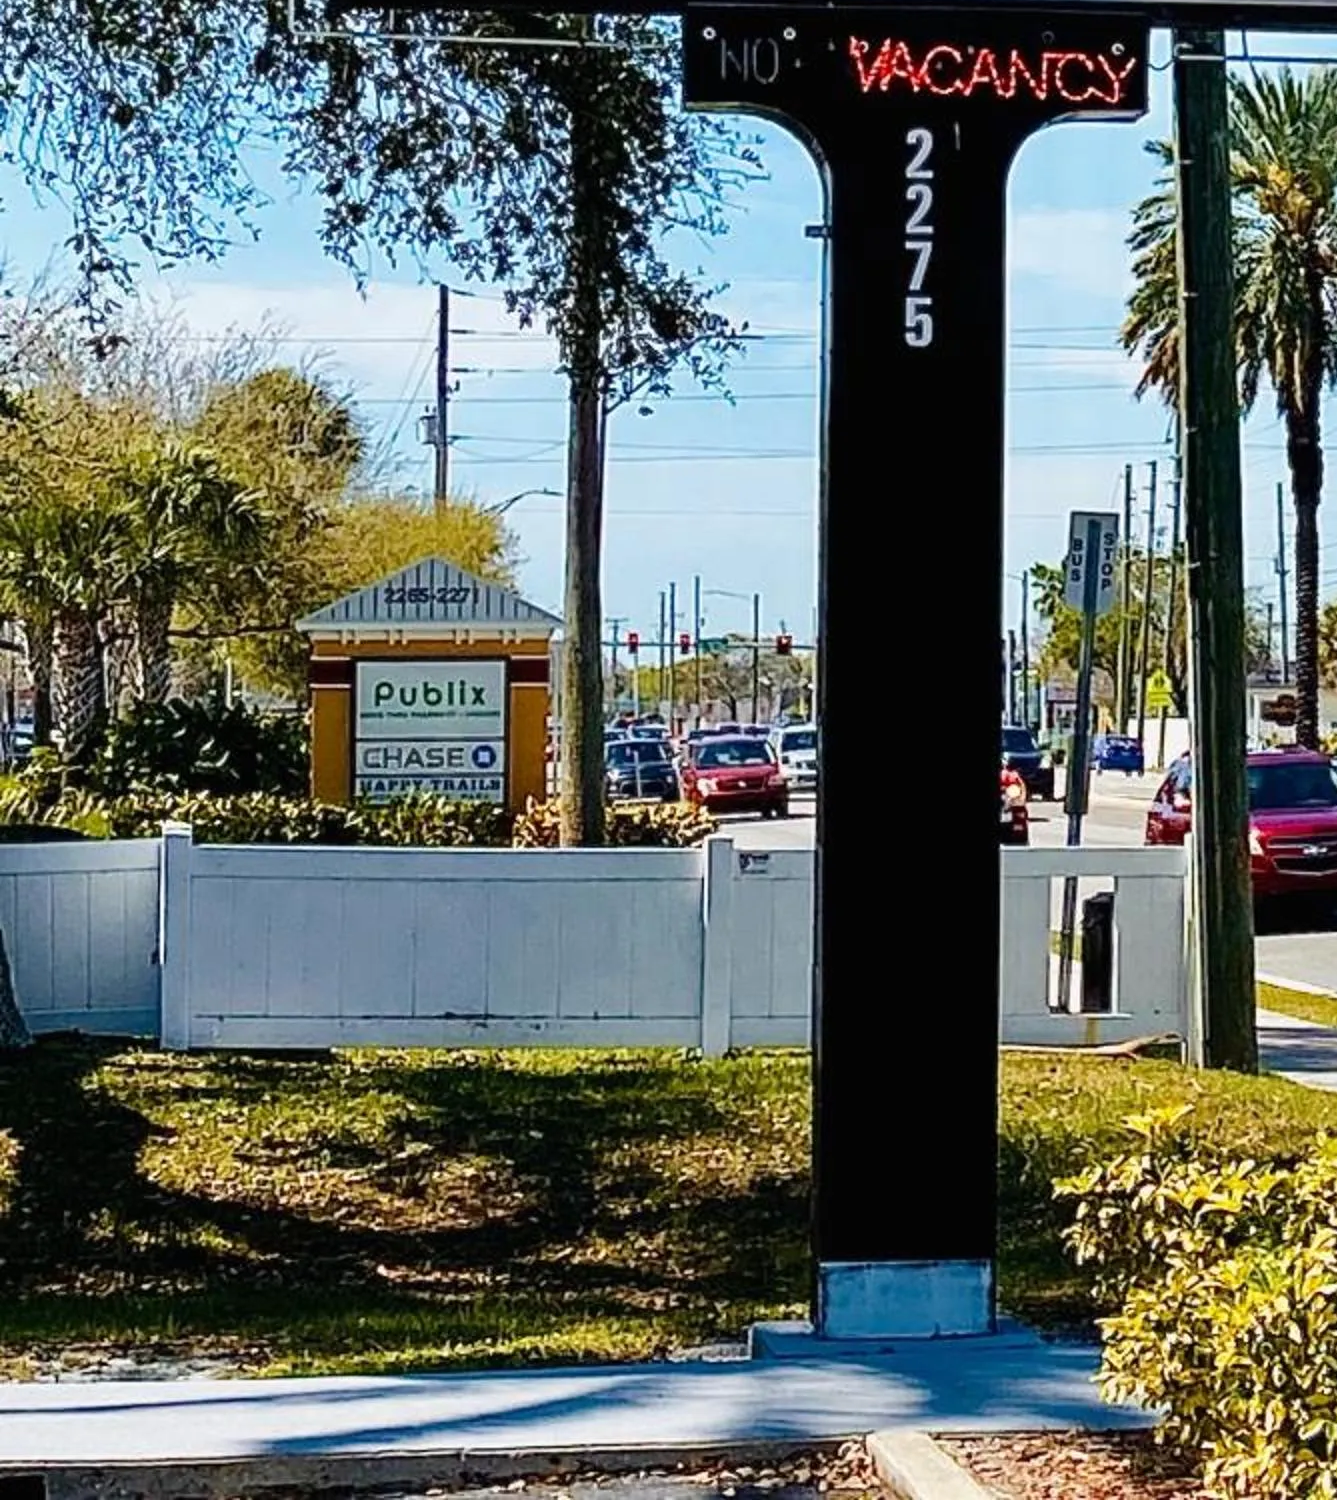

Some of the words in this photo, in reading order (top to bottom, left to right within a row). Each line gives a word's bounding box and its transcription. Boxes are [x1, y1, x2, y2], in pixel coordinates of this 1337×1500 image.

[720, 37, 780, 85] NO
[849, 35, 1136, 103] VACANCY
[904, 128, 934, 347] 2275
[1070, 538, 1083, 582] BUS
[1101, 533, 1115, 591] STOP
[374, 679, 486, 707] Publix
[362, 746, 465, 769] CHASE
